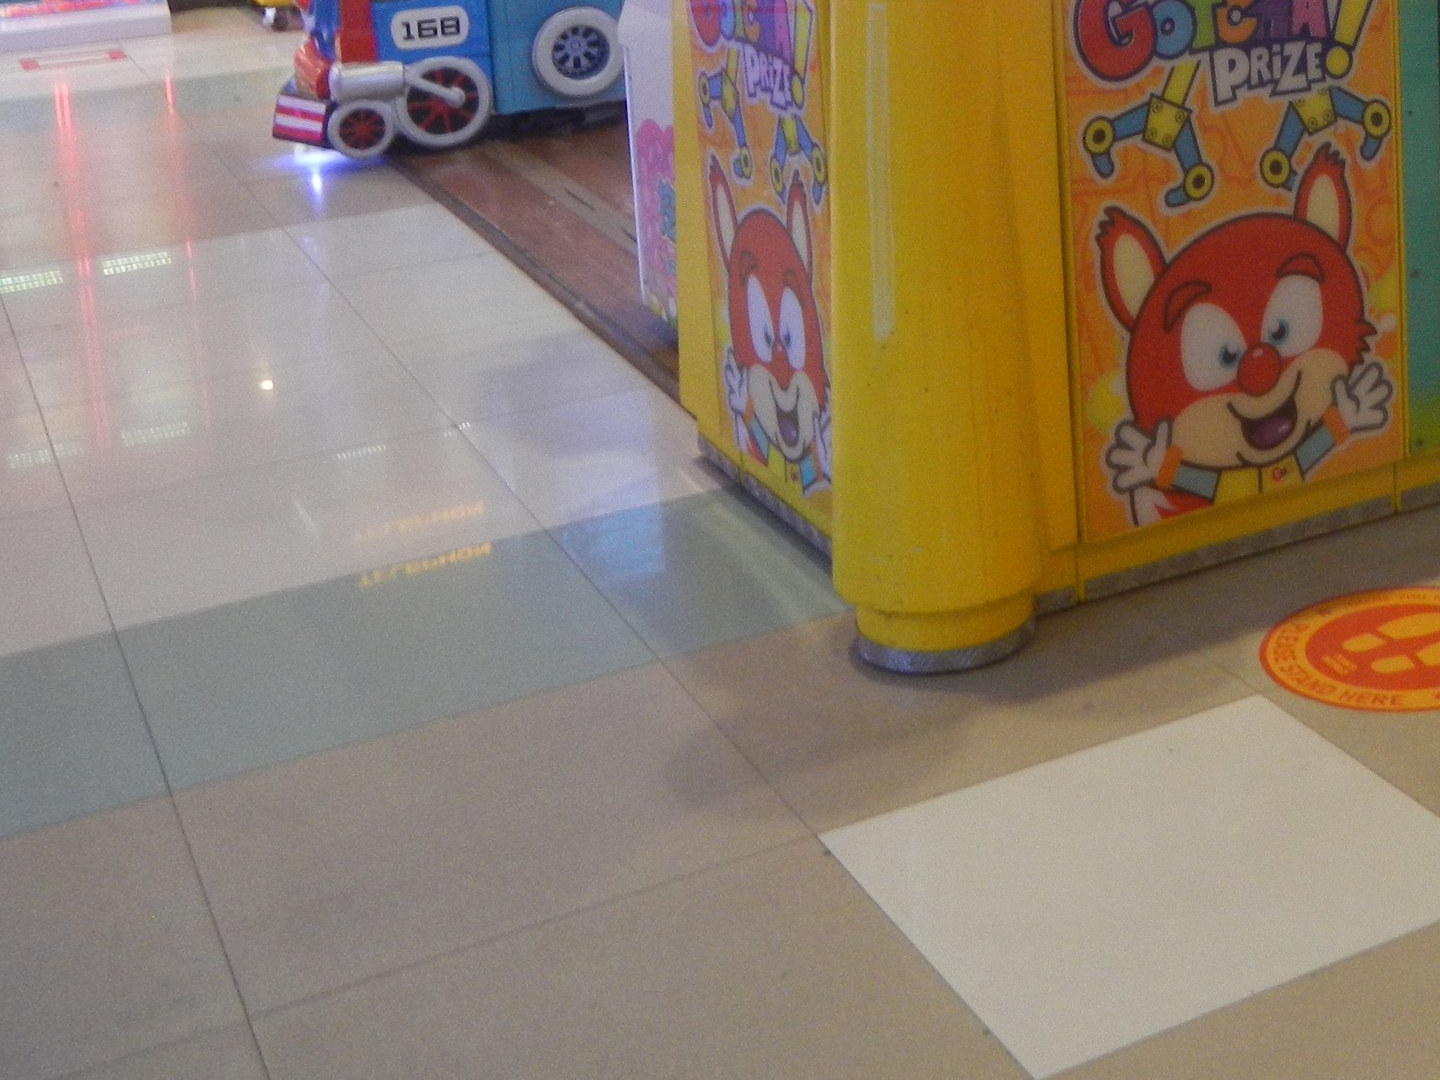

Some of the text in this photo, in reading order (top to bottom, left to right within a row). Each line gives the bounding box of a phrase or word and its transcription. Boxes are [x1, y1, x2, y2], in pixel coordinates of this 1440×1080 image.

[401, 16, 461, 41] 168
[743, 44, 794, 110] PRIZE
[1211, 41, 1331, 107] PRIZE
